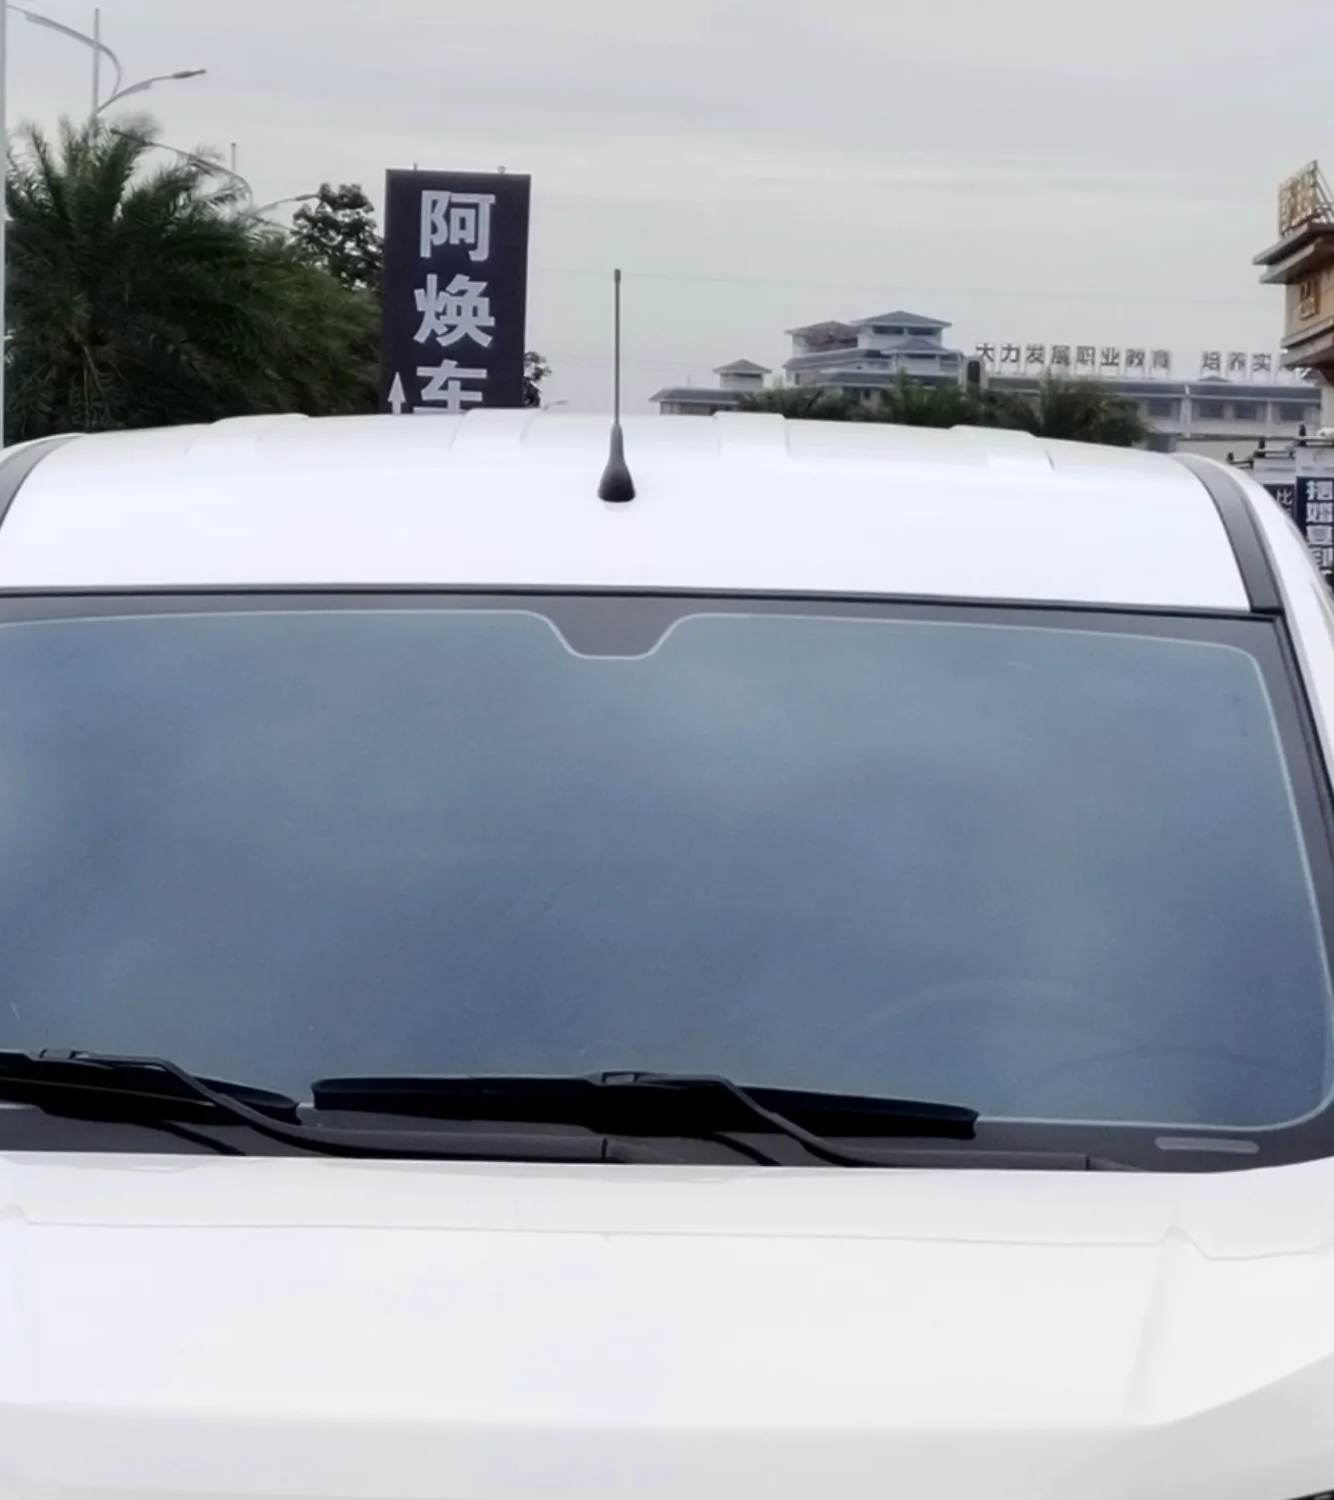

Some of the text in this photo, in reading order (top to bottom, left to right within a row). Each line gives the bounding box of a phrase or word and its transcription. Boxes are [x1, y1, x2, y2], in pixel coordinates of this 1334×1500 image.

[413, 190, 497, 415] 阿焕车
[975, 343, 1172, 370] 大力发展职业教育
